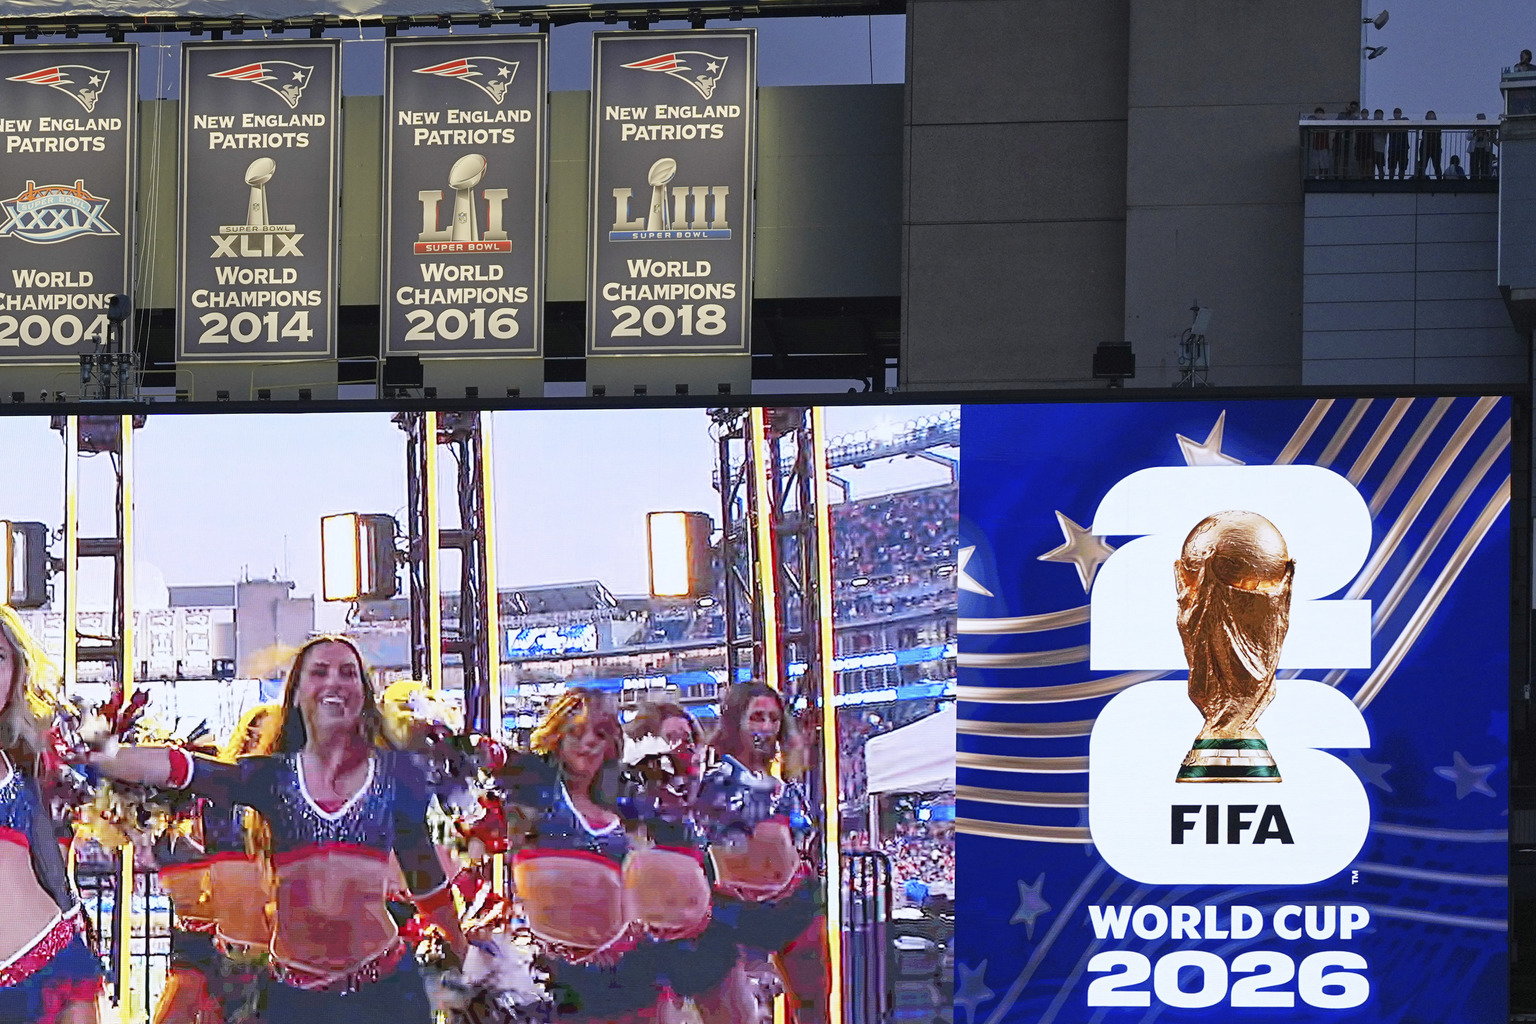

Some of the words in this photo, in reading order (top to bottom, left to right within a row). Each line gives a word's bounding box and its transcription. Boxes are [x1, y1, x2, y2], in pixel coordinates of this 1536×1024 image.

[193, 114, 234, 129] NEW
[241, 113, 326, 128] ENGLAND
[398, 110, 438, 125] NEW
[447, 108, 531, 124] ENGLAND
[605, 106, 645, 121] NEW
[654, 104, 740, 120] ENGLAND
[38, 117, 122, 133] ENGLAND
[620, 123, 724, 141] PATRIOTS
[6, 135, 106, 153] PATRIOTS
[208, 131, 309, 150] PATRIOTS
[413, 127, 515, 145] PATRIOTS
[21, 198, 55, 211] SUPER
[58, 196, 87, 208] BOWL
[632, 232, 668, 240] SUPER
[672, 231, 708, 239] BOWL
[210, 233, 304, 258] XLIX
[425, 243, 461, 252] SUPER
[465, 242, 500, 251] BOWL
[215, 266, 298, 285] WORLD
[420, 263, 503, 282] WORLD
[627, 259, 711, 277] WORLD
[12, 270, 94, 288] WORLD
[191, 288, 322, 309] CHAMPIONS
[396, 286, 528, 305] CHAMPIONS
[602, 282, 736, 301] CHAMPIONS
[198, 311, 313, 344] 2014
[404, 308, 519, 342] 2016
[610, 304, 727, 338] 2018
[1171, 804, 1294, 845] FIFA
[1087, 904, 1264, 940] WORLD
[1272, 904, 1370, 940] CUP
[1087, 950, 1370, 1009] 2026
